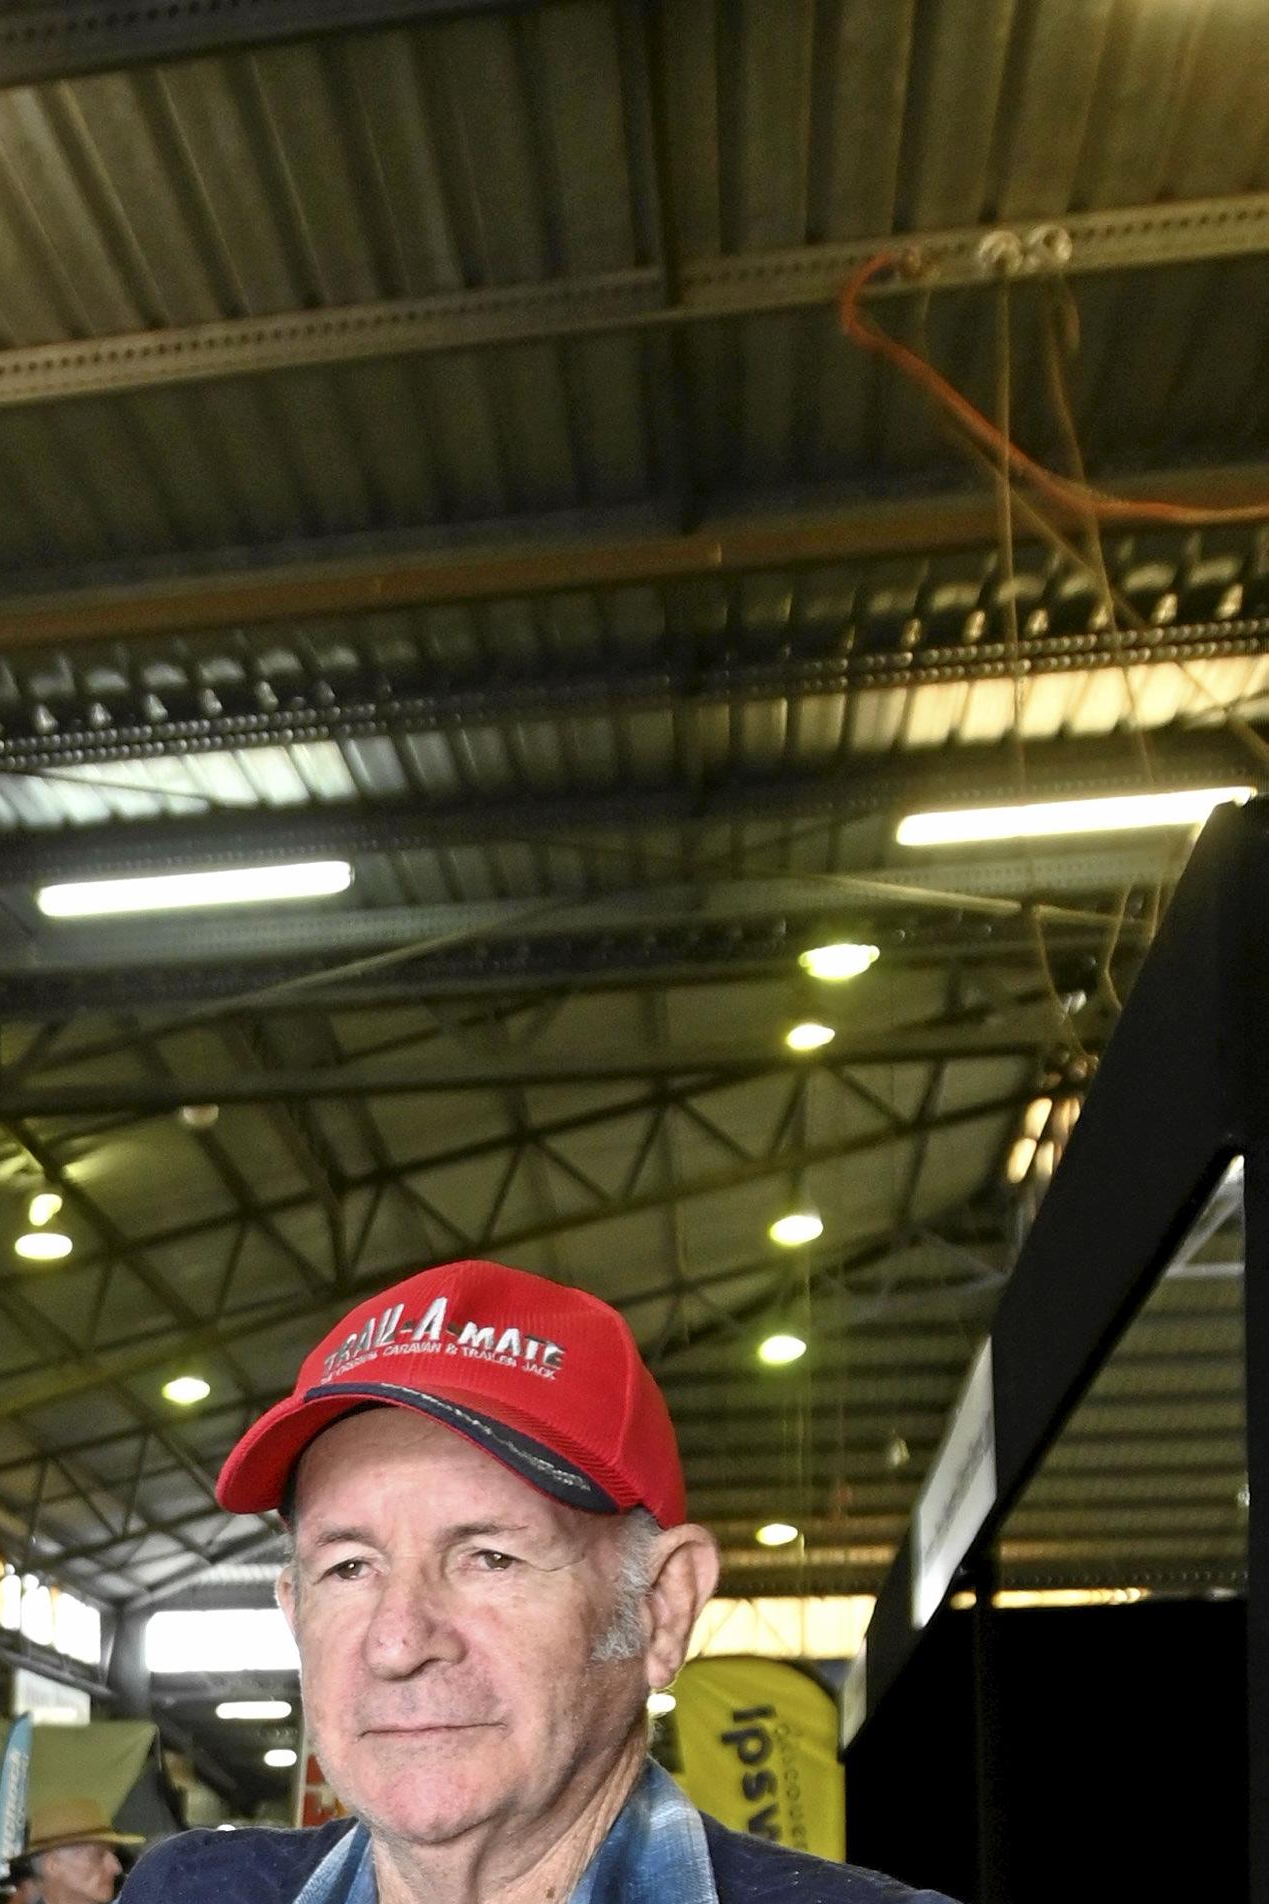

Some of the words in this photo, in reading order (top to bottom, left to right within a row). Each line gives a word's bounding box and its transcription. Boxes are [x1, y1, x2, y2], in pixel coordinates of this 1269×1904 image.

[382, 1342, 441, 1356] CARAVAN
[446, 1343, 458, 1355] &
[462, 1346, 517, 1367] TRAILER
[522, 1361, 556, 1380] JACK
